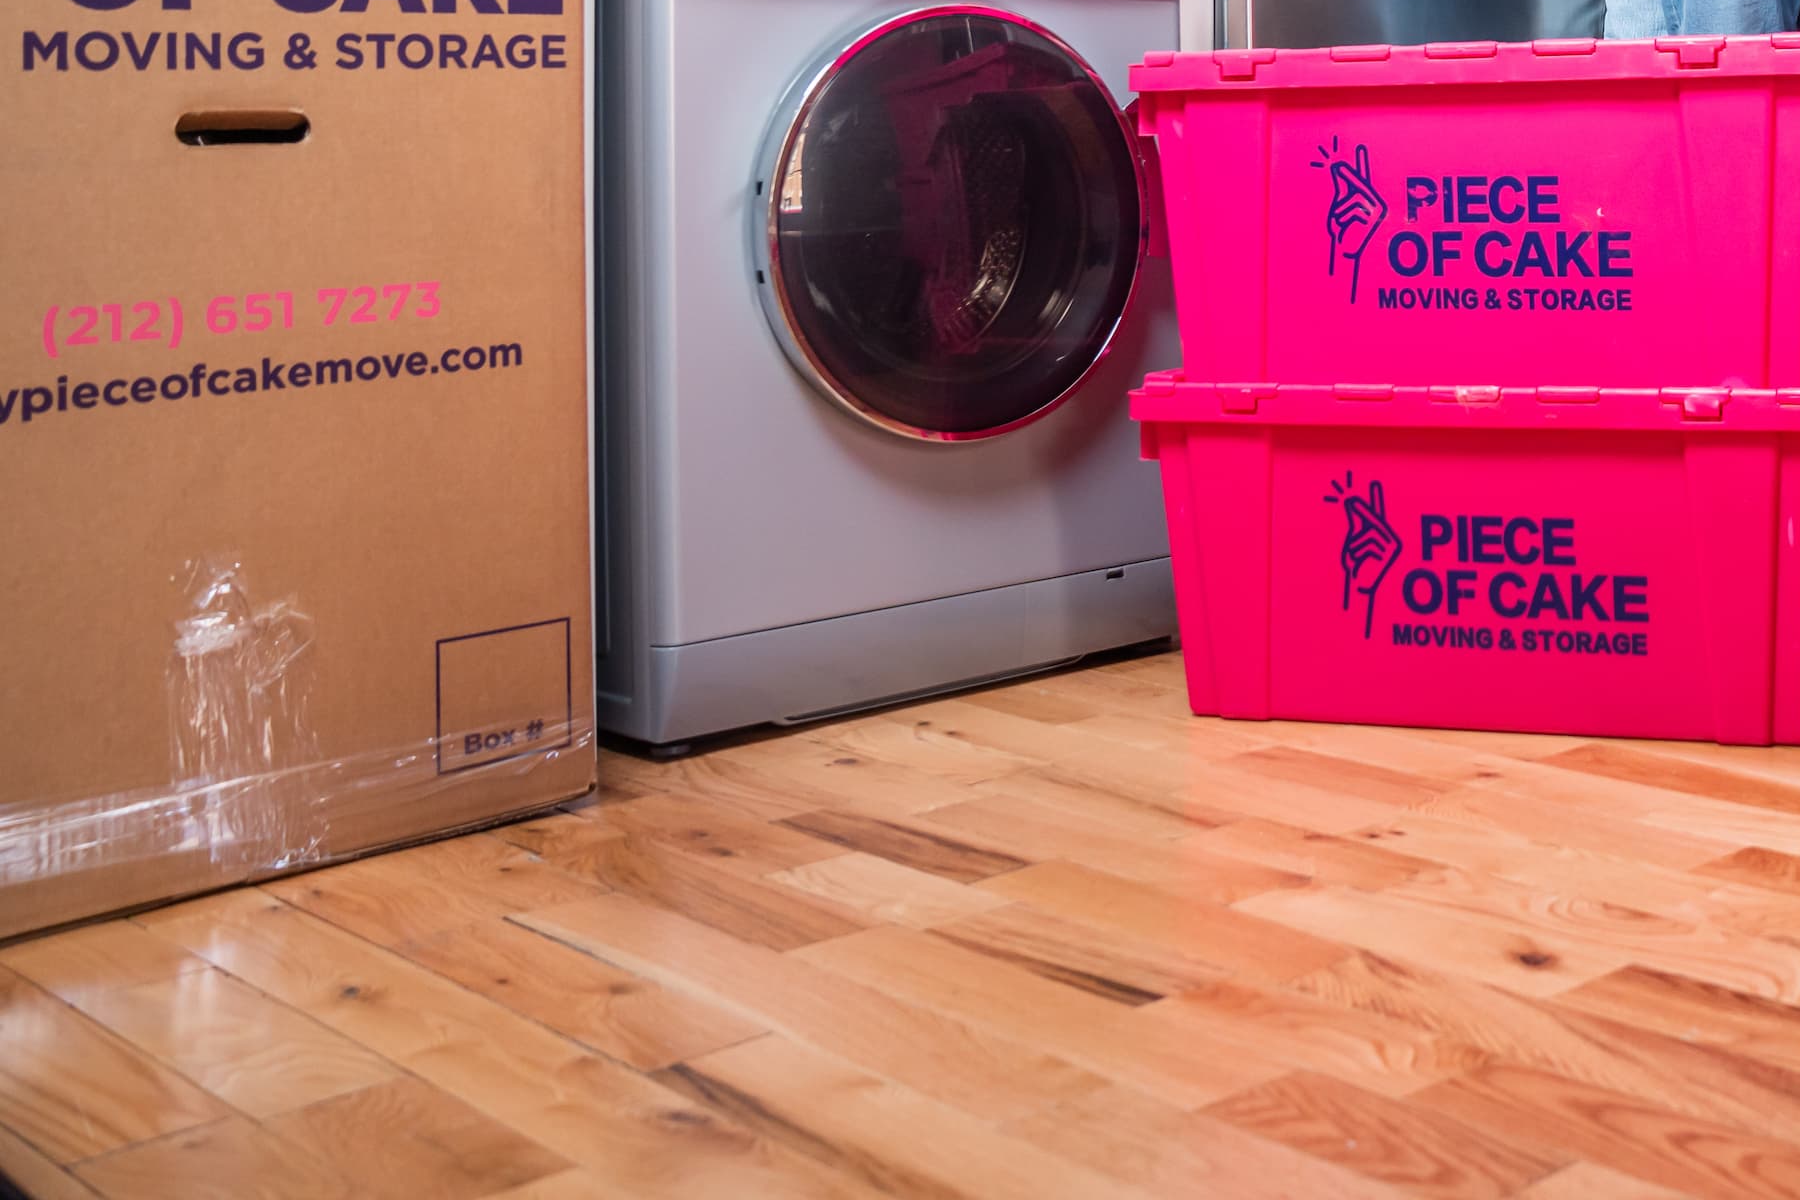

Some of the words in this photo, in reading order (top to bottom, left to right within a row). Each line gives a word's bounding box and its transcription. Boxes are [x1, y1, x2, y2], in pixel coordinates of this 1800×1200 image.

[23, 30, 265, 72] MOVING
[283, 31, 318, 71] &
[335, 33, 567, 70] STORAGE
[1406, 176, 1560, 223] PIECE
[1388, 231, 1463, 277] OF
[1474, 231, 1633, 278] CAKE
[43, 297, 184, 358] (212)
[206, 291, 294, 335] 651
[317, 281, 442, 327] 7273
[1378, 288, 1479, 310] MOVING
[1485, 288, 1502, 309] &
[1507, 288, 1633, 311] STORAGE
[1421, 514, 1576, 566] PIECE
[1402, 568, 1477, 616] OF
[1489, 571, 1649, 622] CAKE
[1393, 624, 1493, 650] MOVING
[1499, 629, 1516, 650] &
[1522, 630, 1648, 655] STORAGE
[464, 728, 515, 756] Box
[526, 717, 545, 742] #
